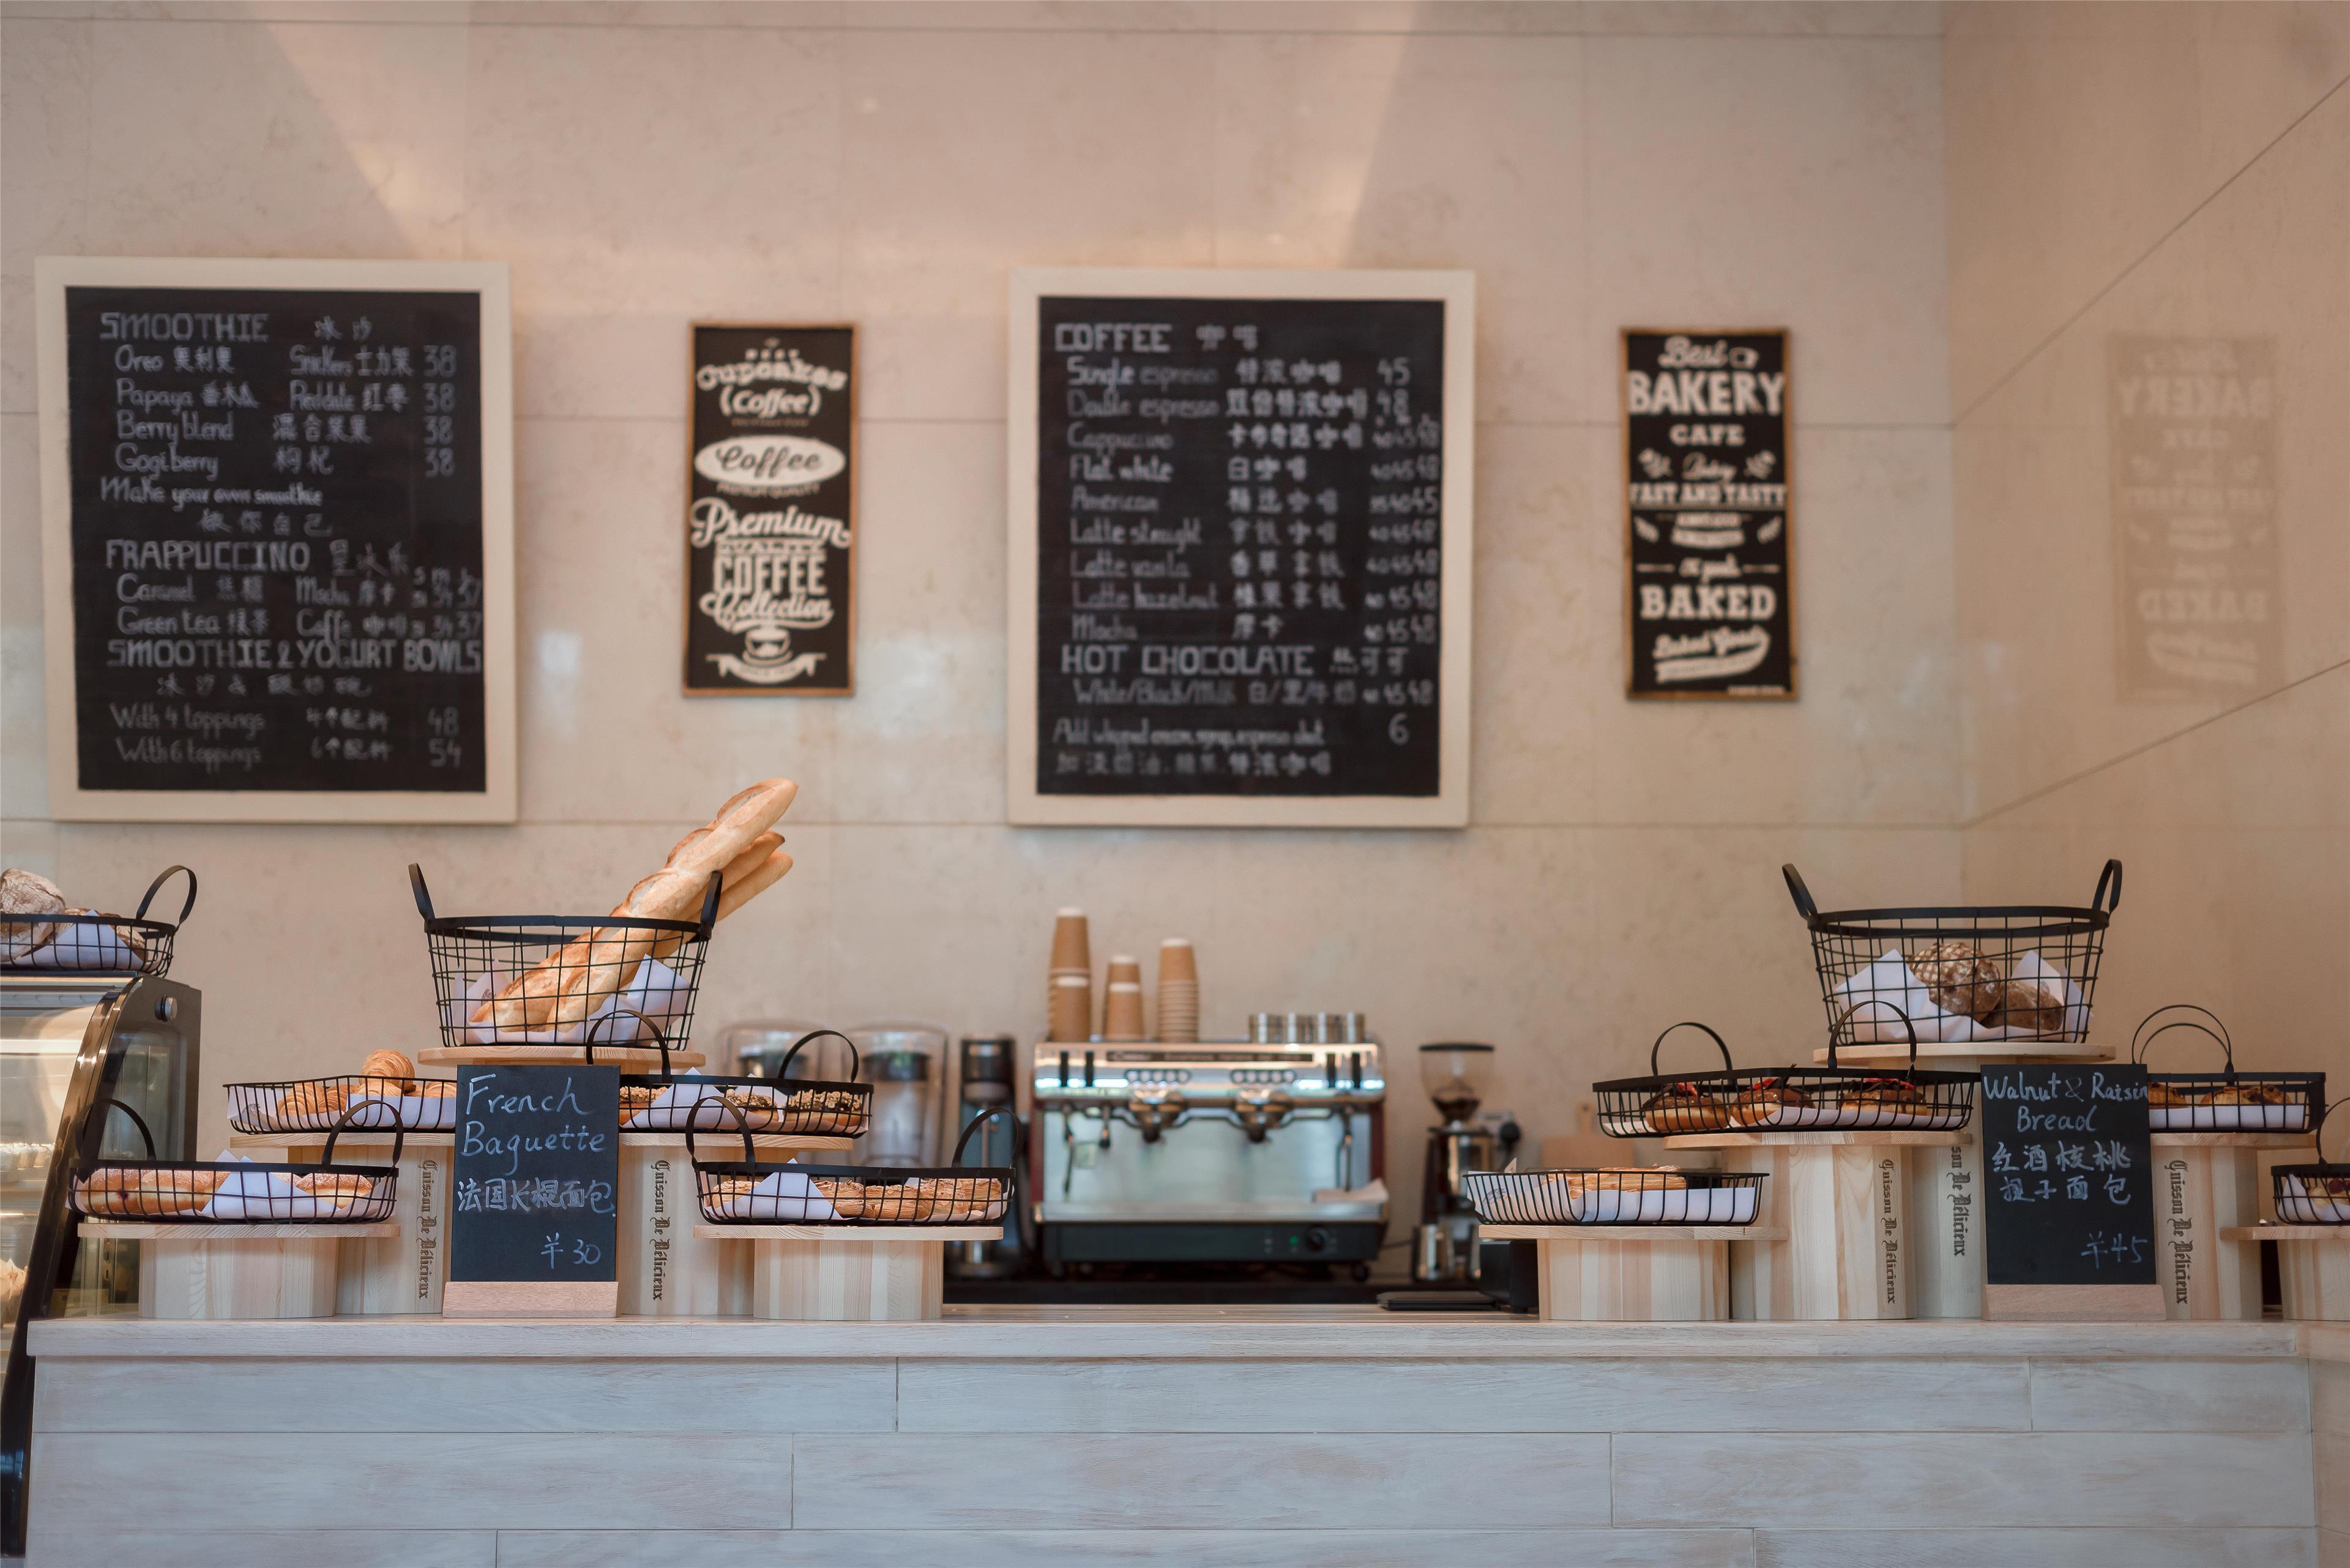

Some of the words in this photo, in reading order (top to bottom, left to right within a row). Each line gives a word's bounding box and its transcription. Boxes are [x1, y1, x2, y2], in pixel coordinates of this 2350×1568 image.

[99, 313, 268, 342] SMOOTHIE
[1055, 323, 1172, 353] COFFEE
[115, 344, 163, 373] Oreo
[423, 345, 457, 378] 38
[1658, 337, 1728, 368] Best
[1376, 357, 1410, 386] 45
[116, 378, 194, 415] Papaya
[423, 383, 455, 413] 38
[1627, 370, 1785, 416] BAKERY
[116, 409, 179, 445] Berry
[183, 410, 234, 441] blend
[423, 416, 453, 445] 38
[1669, 424, 1745, 446] CAFE
[423, 447, 454, 478] 38
[715, 444, 822, 479] Coffee
[100, 476, 166, 504] Make
[171, 488, 210, 512] your
[214, 488, 251, 504] own
[690, 496, 851, 548] Premium
[105, 539, 310, 572] FRAPPUCCINO
[714, 553, 827, 595] COFFEE
[1639, 584, 1776, 621] BAKED
[117, 606, 177, 635] Green
[182, 608, 221, 635] tea
[106, 638, 271, 668] SMOOTHIE
[296, 638, 397, 669] YOGURT
[403, 638, 481, 673] BOWLS
[1061, 644, 1128, 674] HOT
[1141, 644, 1315, 676] CHOCOLATE
[109, 702, 160, 730] With
[163, 705, 179, 729] 4
[184, 702, 265, 741] toppings
[426, 706, 461, 736] 48
[1387, 712, 1409, 746] 6
[114, 736, 165, 763] With
[168, 739, 184, 763] 6
[186, 736, 262, 774] toppings
[428, 738, 462, 769] 54
[466, 1073, 591, 1116] French
[1983, 1071, 2062, 1102] Walnut
[2064, 1077, 2084, 1102] &
[2091, 1072, 2149, 1102] Raisin
[2016, 1104, 2098, 1133] Bread
[460, 1121, 606, 1176] Baguette
[1992, 1140, 2131, 1173] 红酒核桃
[458, 1177, 614, 1214] 法国长棍面包
[1945, 1171, 1971, 1191] De
[416, 1215, 438, 1234] De
[649, 1216, 671, 1236] De
[1880, 1217, 1897, 1237] De
[1947, 1193, 1972, 1256] Délicieux
[2166, 1217, 2193, 1237] De
[416, 1238, 437, 1299] Délicieux
[649, 1238, 671, 1301] Délicieux
[1881, 1239, 1898, 1304] Délicieux
[2168, 1240, 2193, 1305] Délicieux
